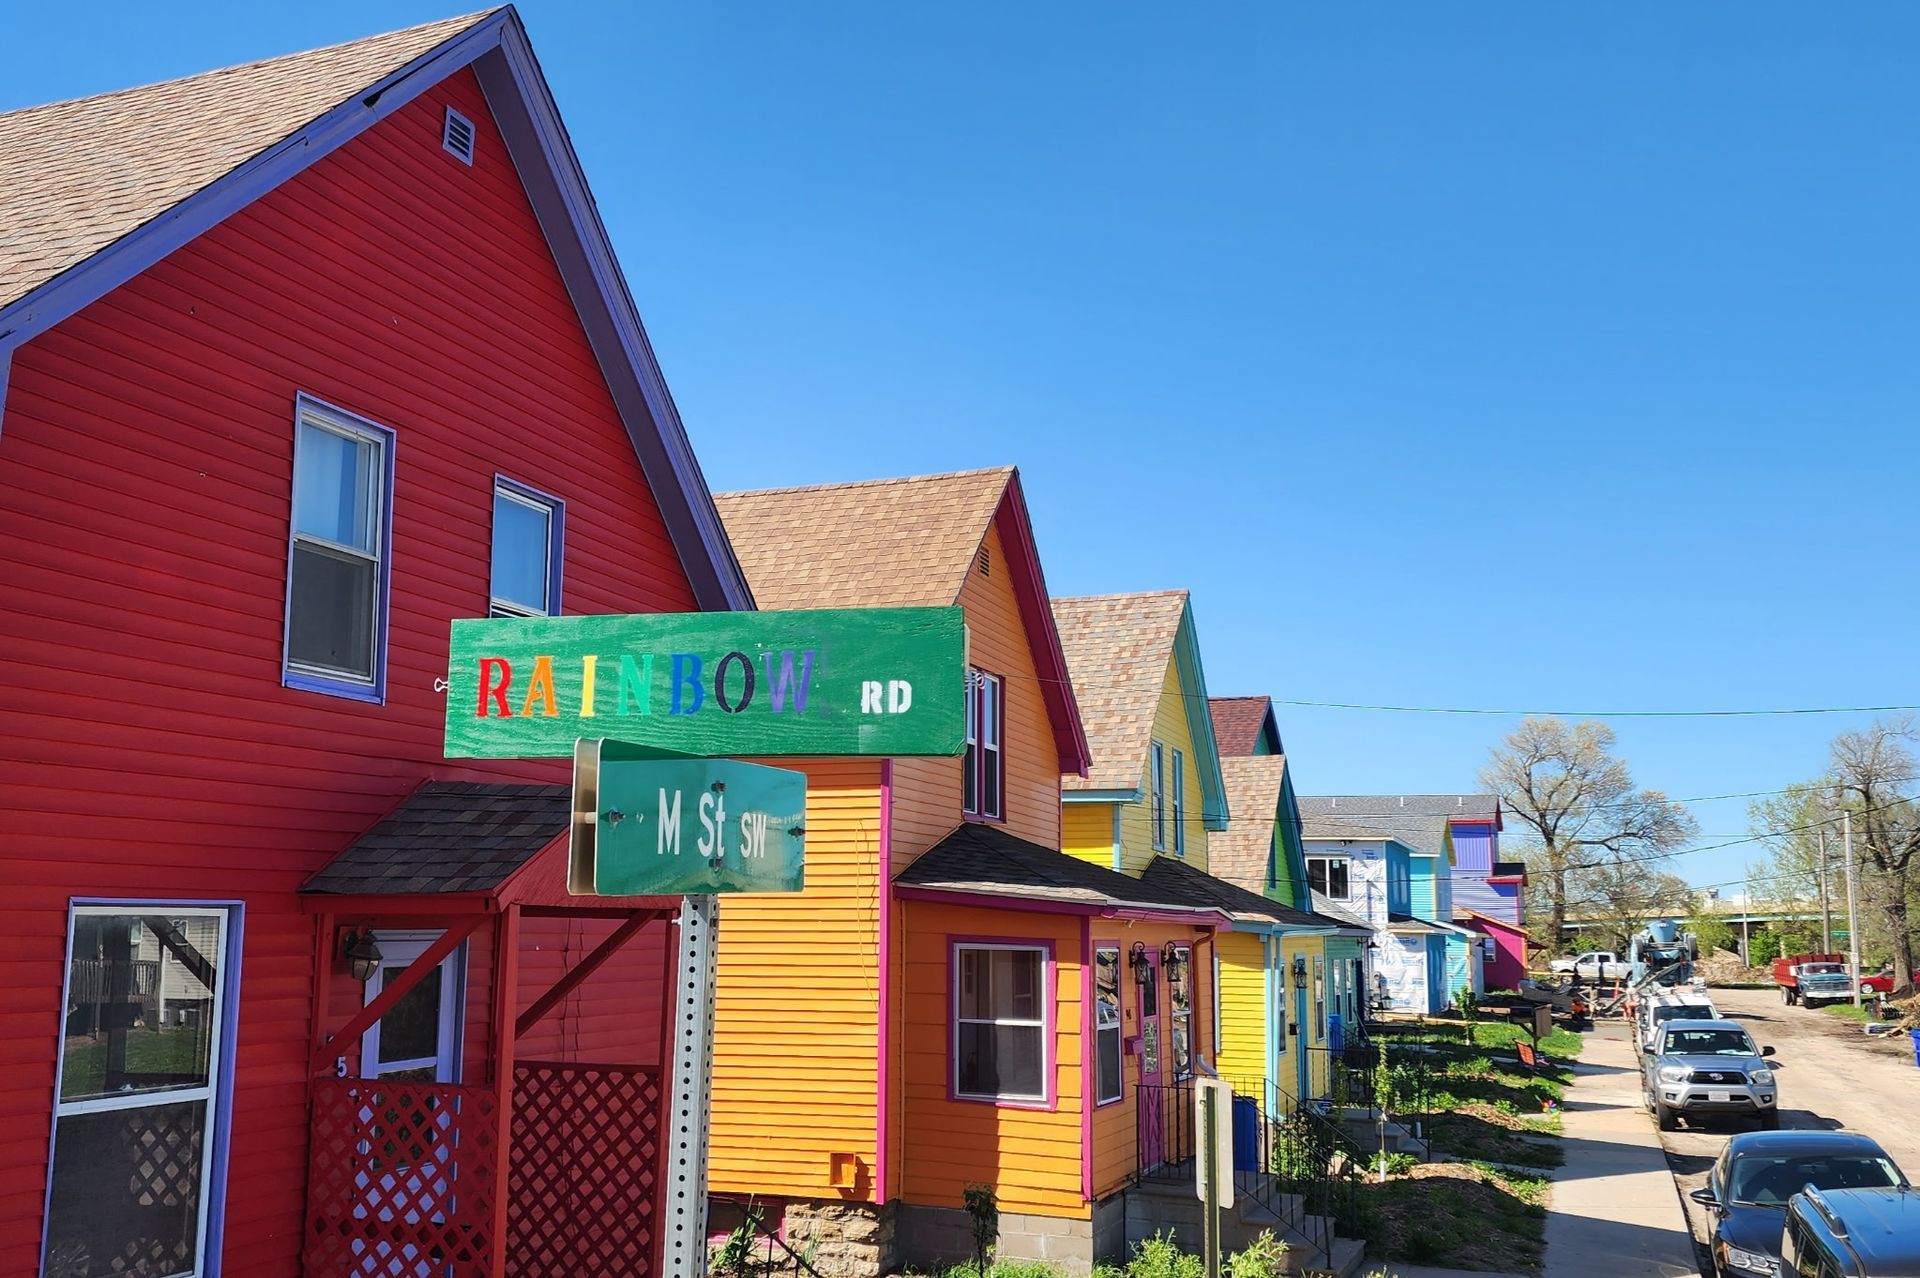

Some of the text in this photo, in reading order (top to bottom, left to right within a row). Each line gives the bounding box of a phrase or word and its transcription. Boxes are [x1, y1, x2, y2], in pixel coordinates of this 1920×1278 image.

[475, 651, 912, 717] RAINBOW RD
[657, 787, 767, 858] M St SW
